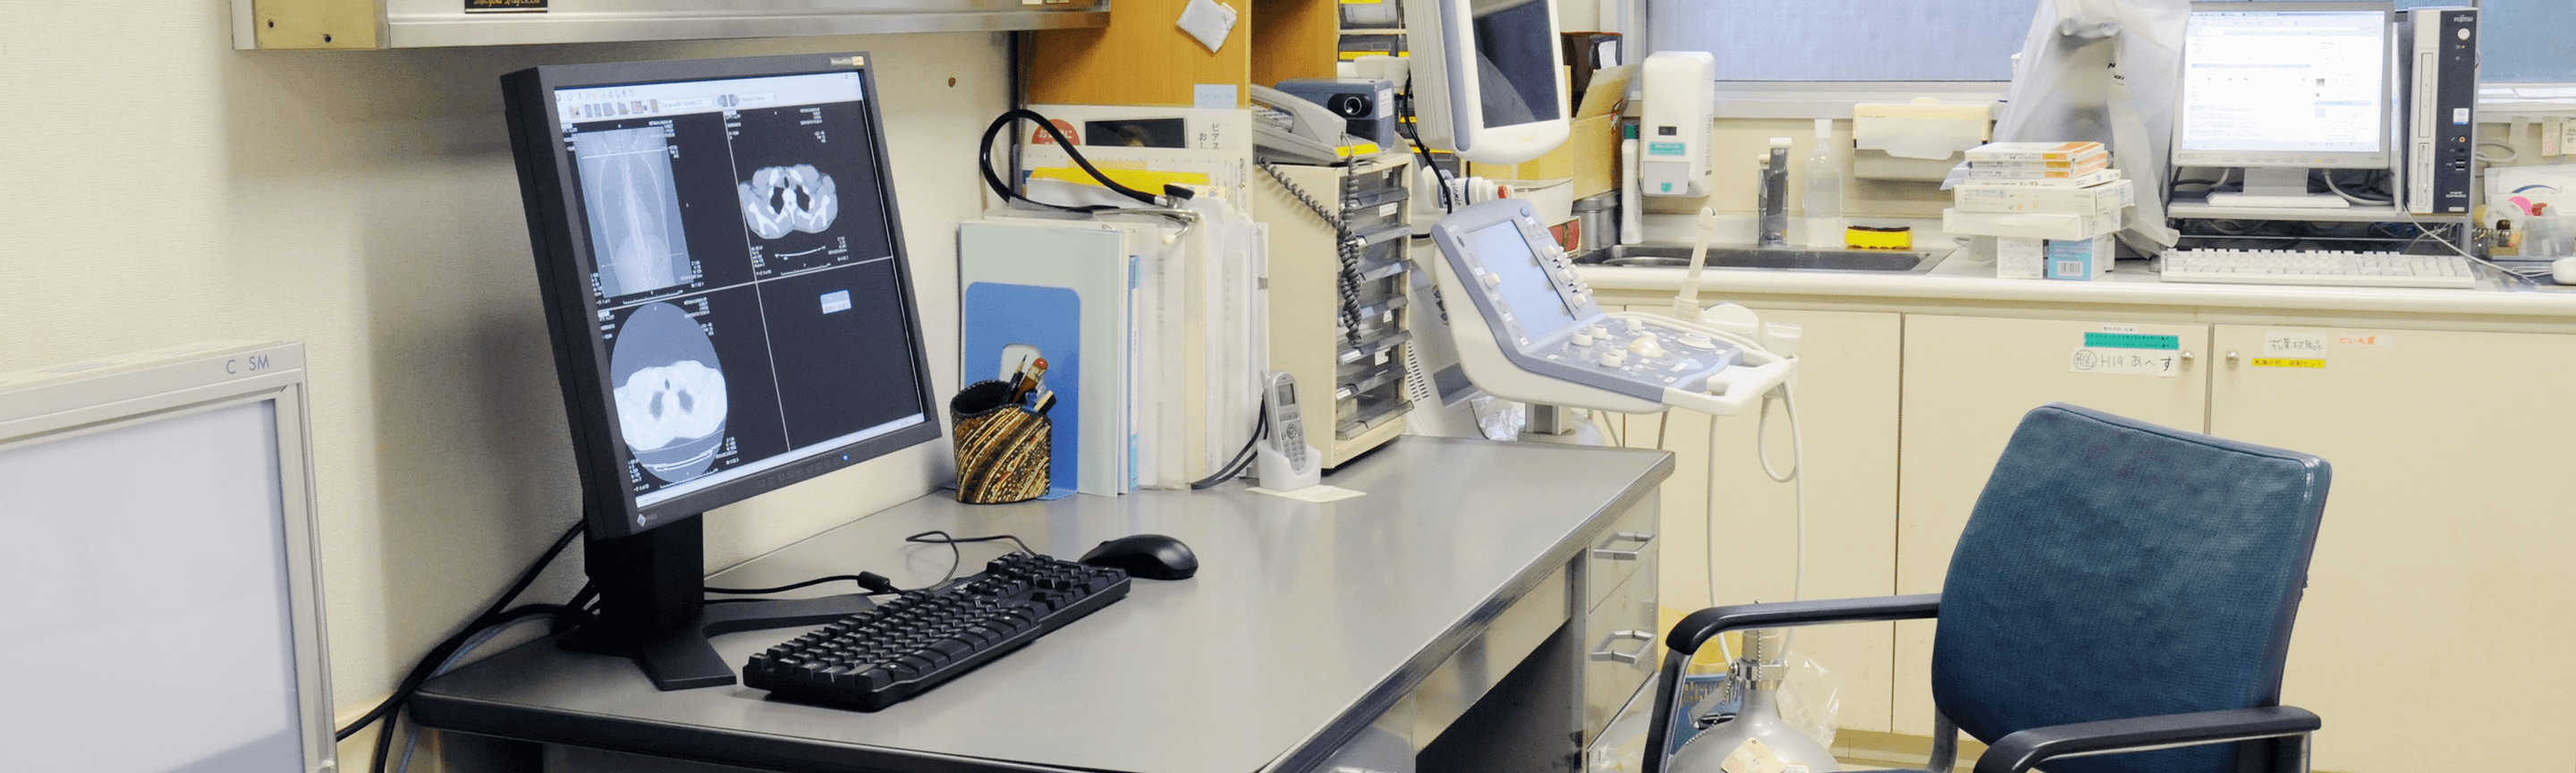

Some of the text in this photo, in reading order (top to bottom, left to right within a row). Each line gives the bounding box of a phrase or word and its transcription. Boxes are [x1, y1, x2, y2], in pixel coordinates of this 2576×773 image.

[2453, 14, 2473, 22] FUJITSU
[226, 359, 236, 375] C
[2101, 355, 2123, 368] H19
